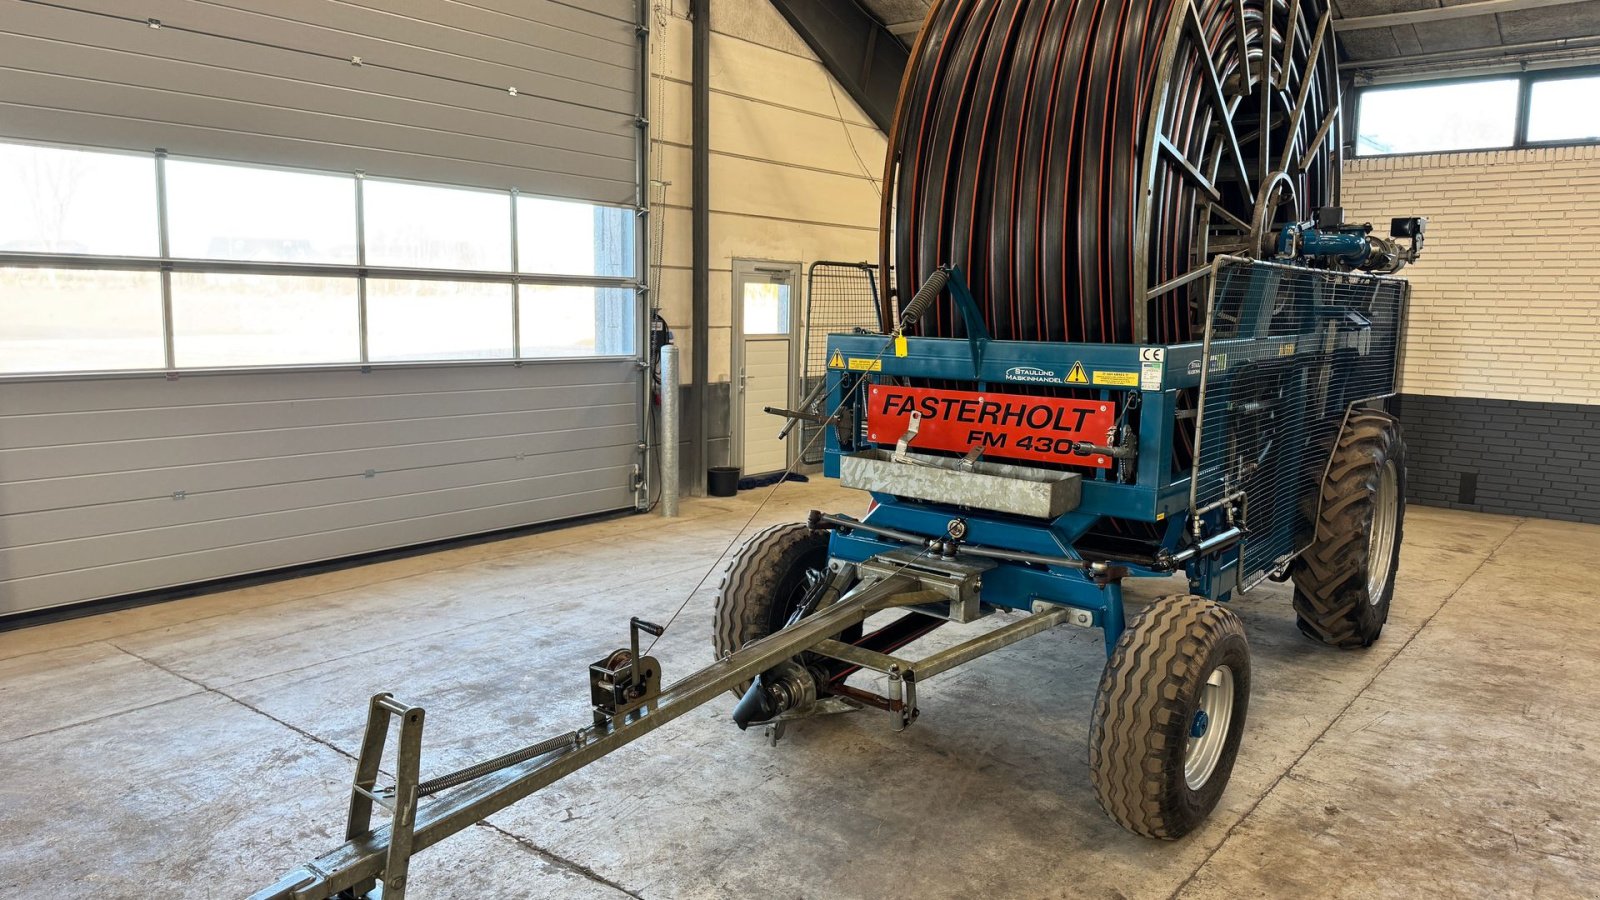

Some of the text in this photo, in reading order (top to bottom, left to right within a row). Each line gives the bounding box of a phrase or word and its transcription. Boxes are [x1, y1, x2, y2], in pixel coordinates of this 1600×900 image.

[1005, 374, 1063, 384] MASKINHANDEL
[1014, 368, 1054, 377] STAULUND
[882, 393, 1096, 433] FASTERHOLT
[966, 430, 1007, 448] FM
